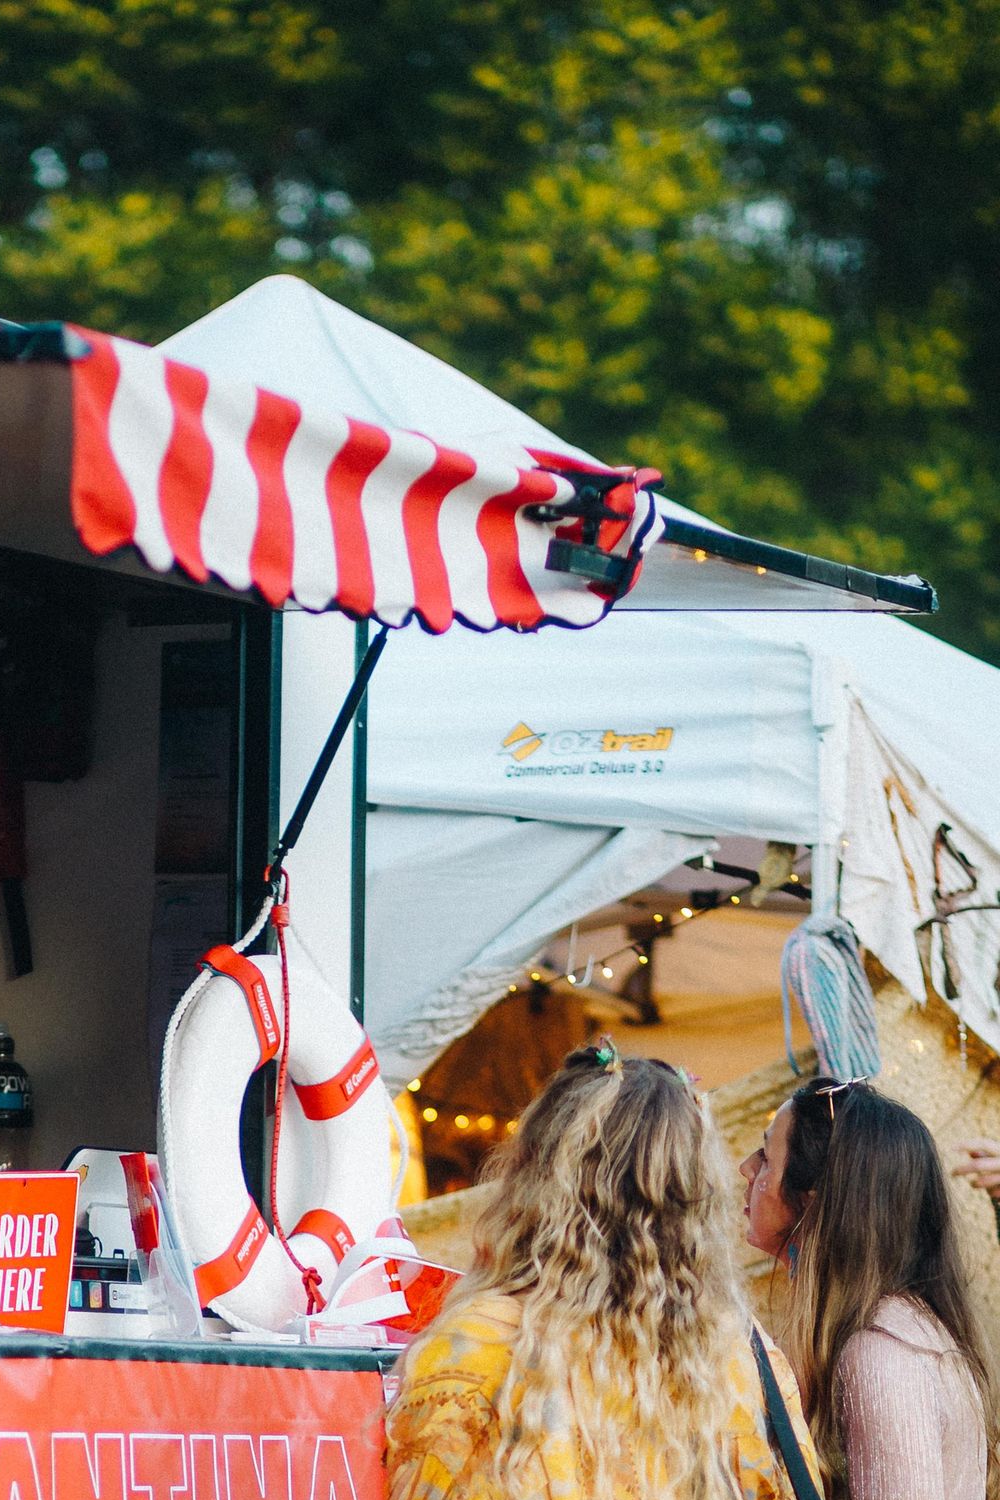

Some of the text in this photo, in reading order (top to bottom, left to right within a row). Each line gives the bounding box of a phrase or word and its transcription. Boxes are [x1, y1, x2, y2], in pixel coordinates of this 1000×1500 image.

[504, 759, 665, 778] Commercial Deluxe 3.0
[254, 984, 274, 1030] Cantina
[351, 1057, 377, 1087] Cantina
[236, 1228, 260, 1263] Cantina
